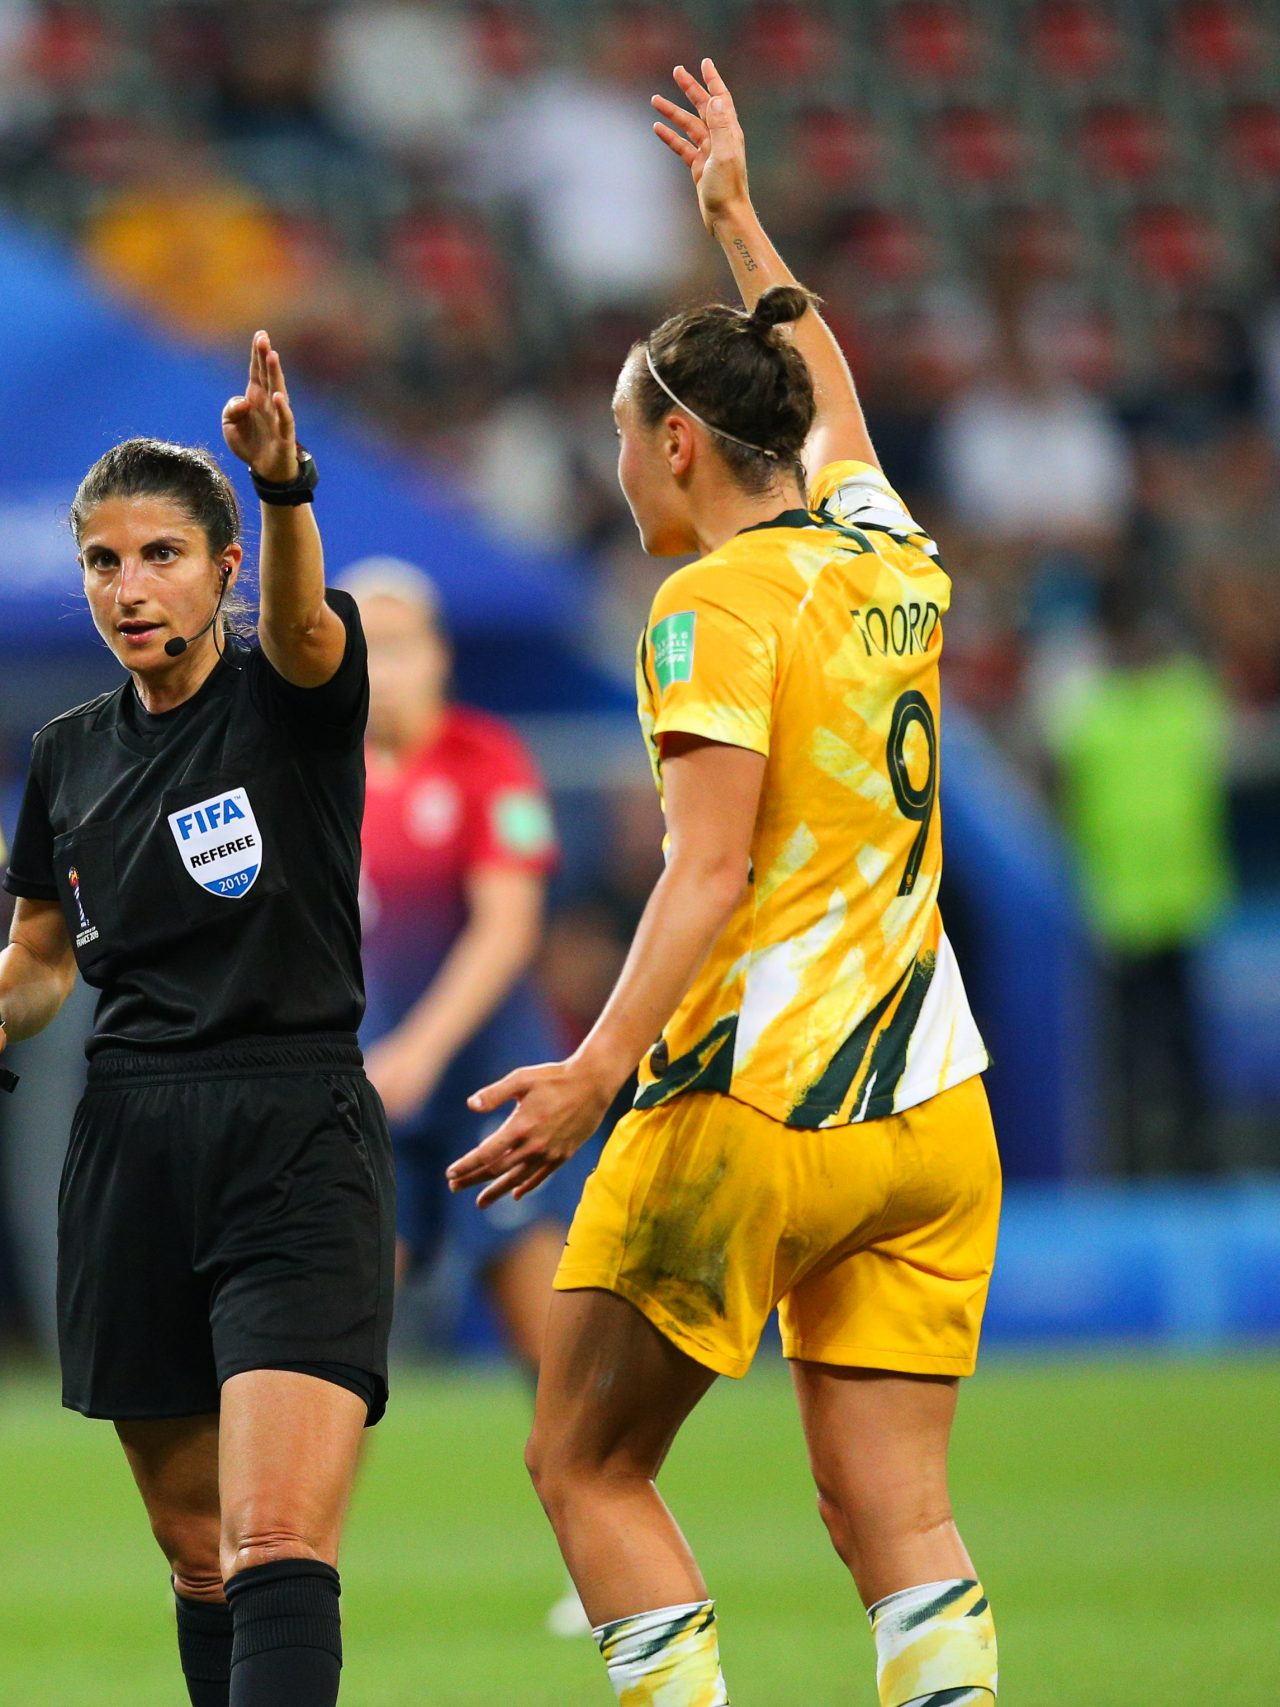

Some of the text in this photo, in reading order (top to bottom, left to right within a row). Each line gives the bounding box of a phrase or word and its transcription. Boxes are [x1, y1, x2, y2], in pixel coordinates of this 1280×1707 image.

[886, 689, 937, 897] 9
[176, 798, 246, 841] FIFA
[190, 834, 256, 868] REFEREE
[218, 873, 249, 892] 2019
